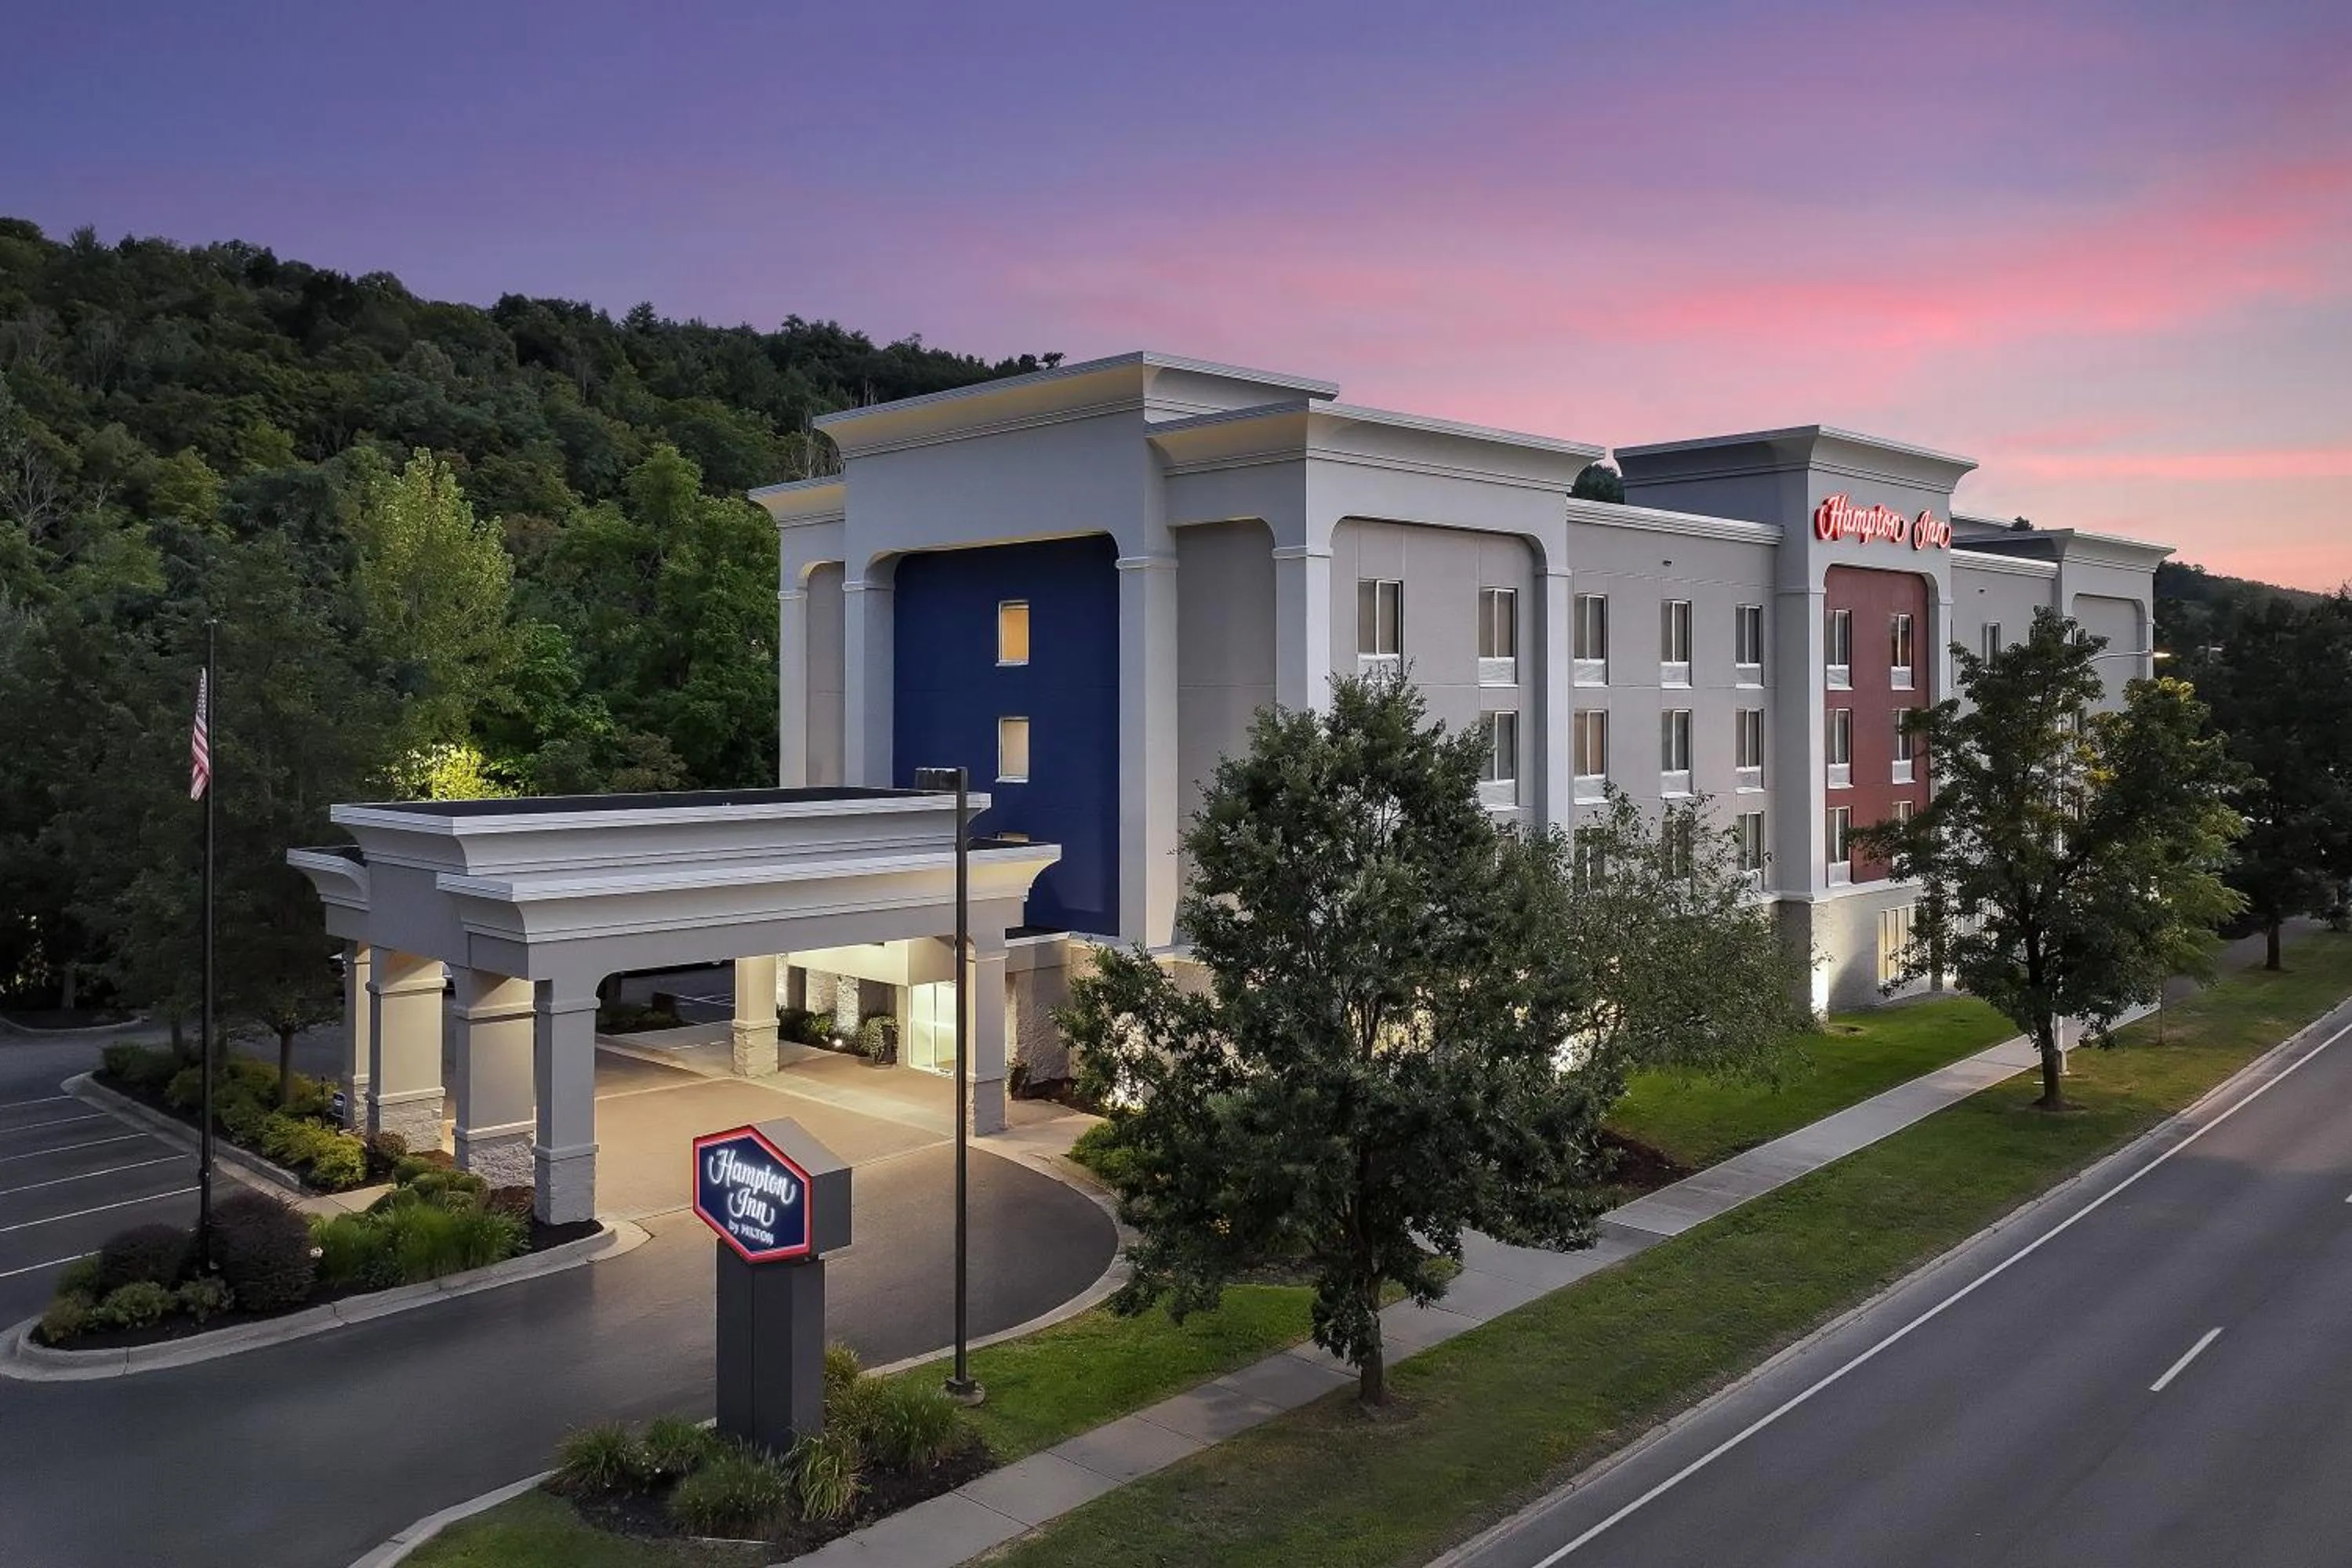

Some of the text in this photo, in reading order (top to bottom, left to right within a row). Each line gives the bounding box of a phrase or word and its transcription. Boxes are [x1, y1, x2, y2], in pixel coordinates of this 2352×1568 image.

[1815, 494, 1951, 550] Hampton Inn
[708, 1149, 797, 1204] Hampton
[728, 1187, 775, 1225] Inn
[741, 1223, 775, 1245] HILTON
